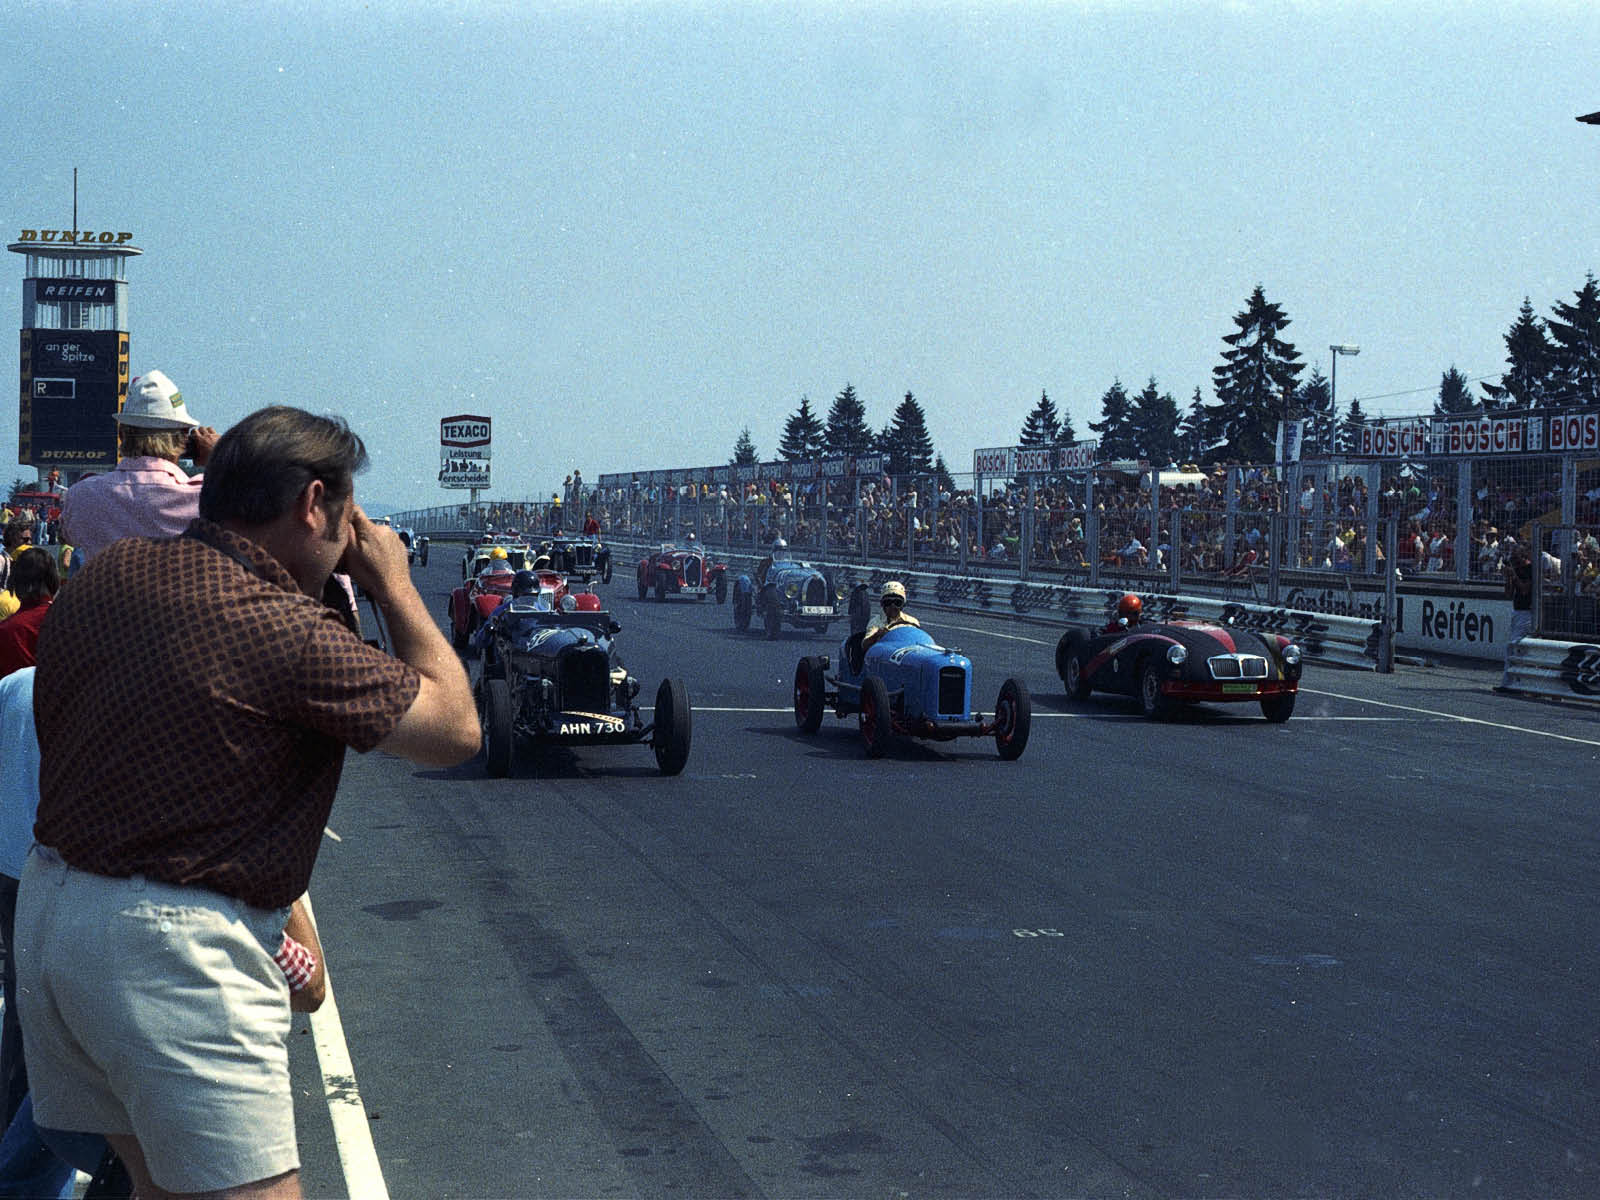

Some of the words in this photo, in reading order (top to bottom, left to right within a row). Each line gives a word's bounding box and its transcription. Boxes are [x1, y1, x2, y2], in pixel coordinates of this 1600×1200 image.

[18, 229, 133, 244] DUNLOP
[45, 285, 106, 297] REIFEN
[62, 342, 81, 351] der
[61, 351, 95, 363] Spitze
[37, 382, 47, 394] R
[443, 425, 488, 438] TEXACO
[1451, 421, 1521, 451] BOSCH
[1363, 424, 1425, 454] BOSCH
[40, 450, 107, 460] DUNLOP
[450, 450, 482, 459] Leistung
[1016, 450, 1049, 471] BOSCH
[1060, 446, 1094, 468] BOSCH
[976, 454, 1007, 472] BOSCH
[443, 473, 488, 483] entscheidet
[1422, 600, 1494, 643] Reifen
[560, 723, 591, 735] AHN
[595, 722, 625, 735] 730
